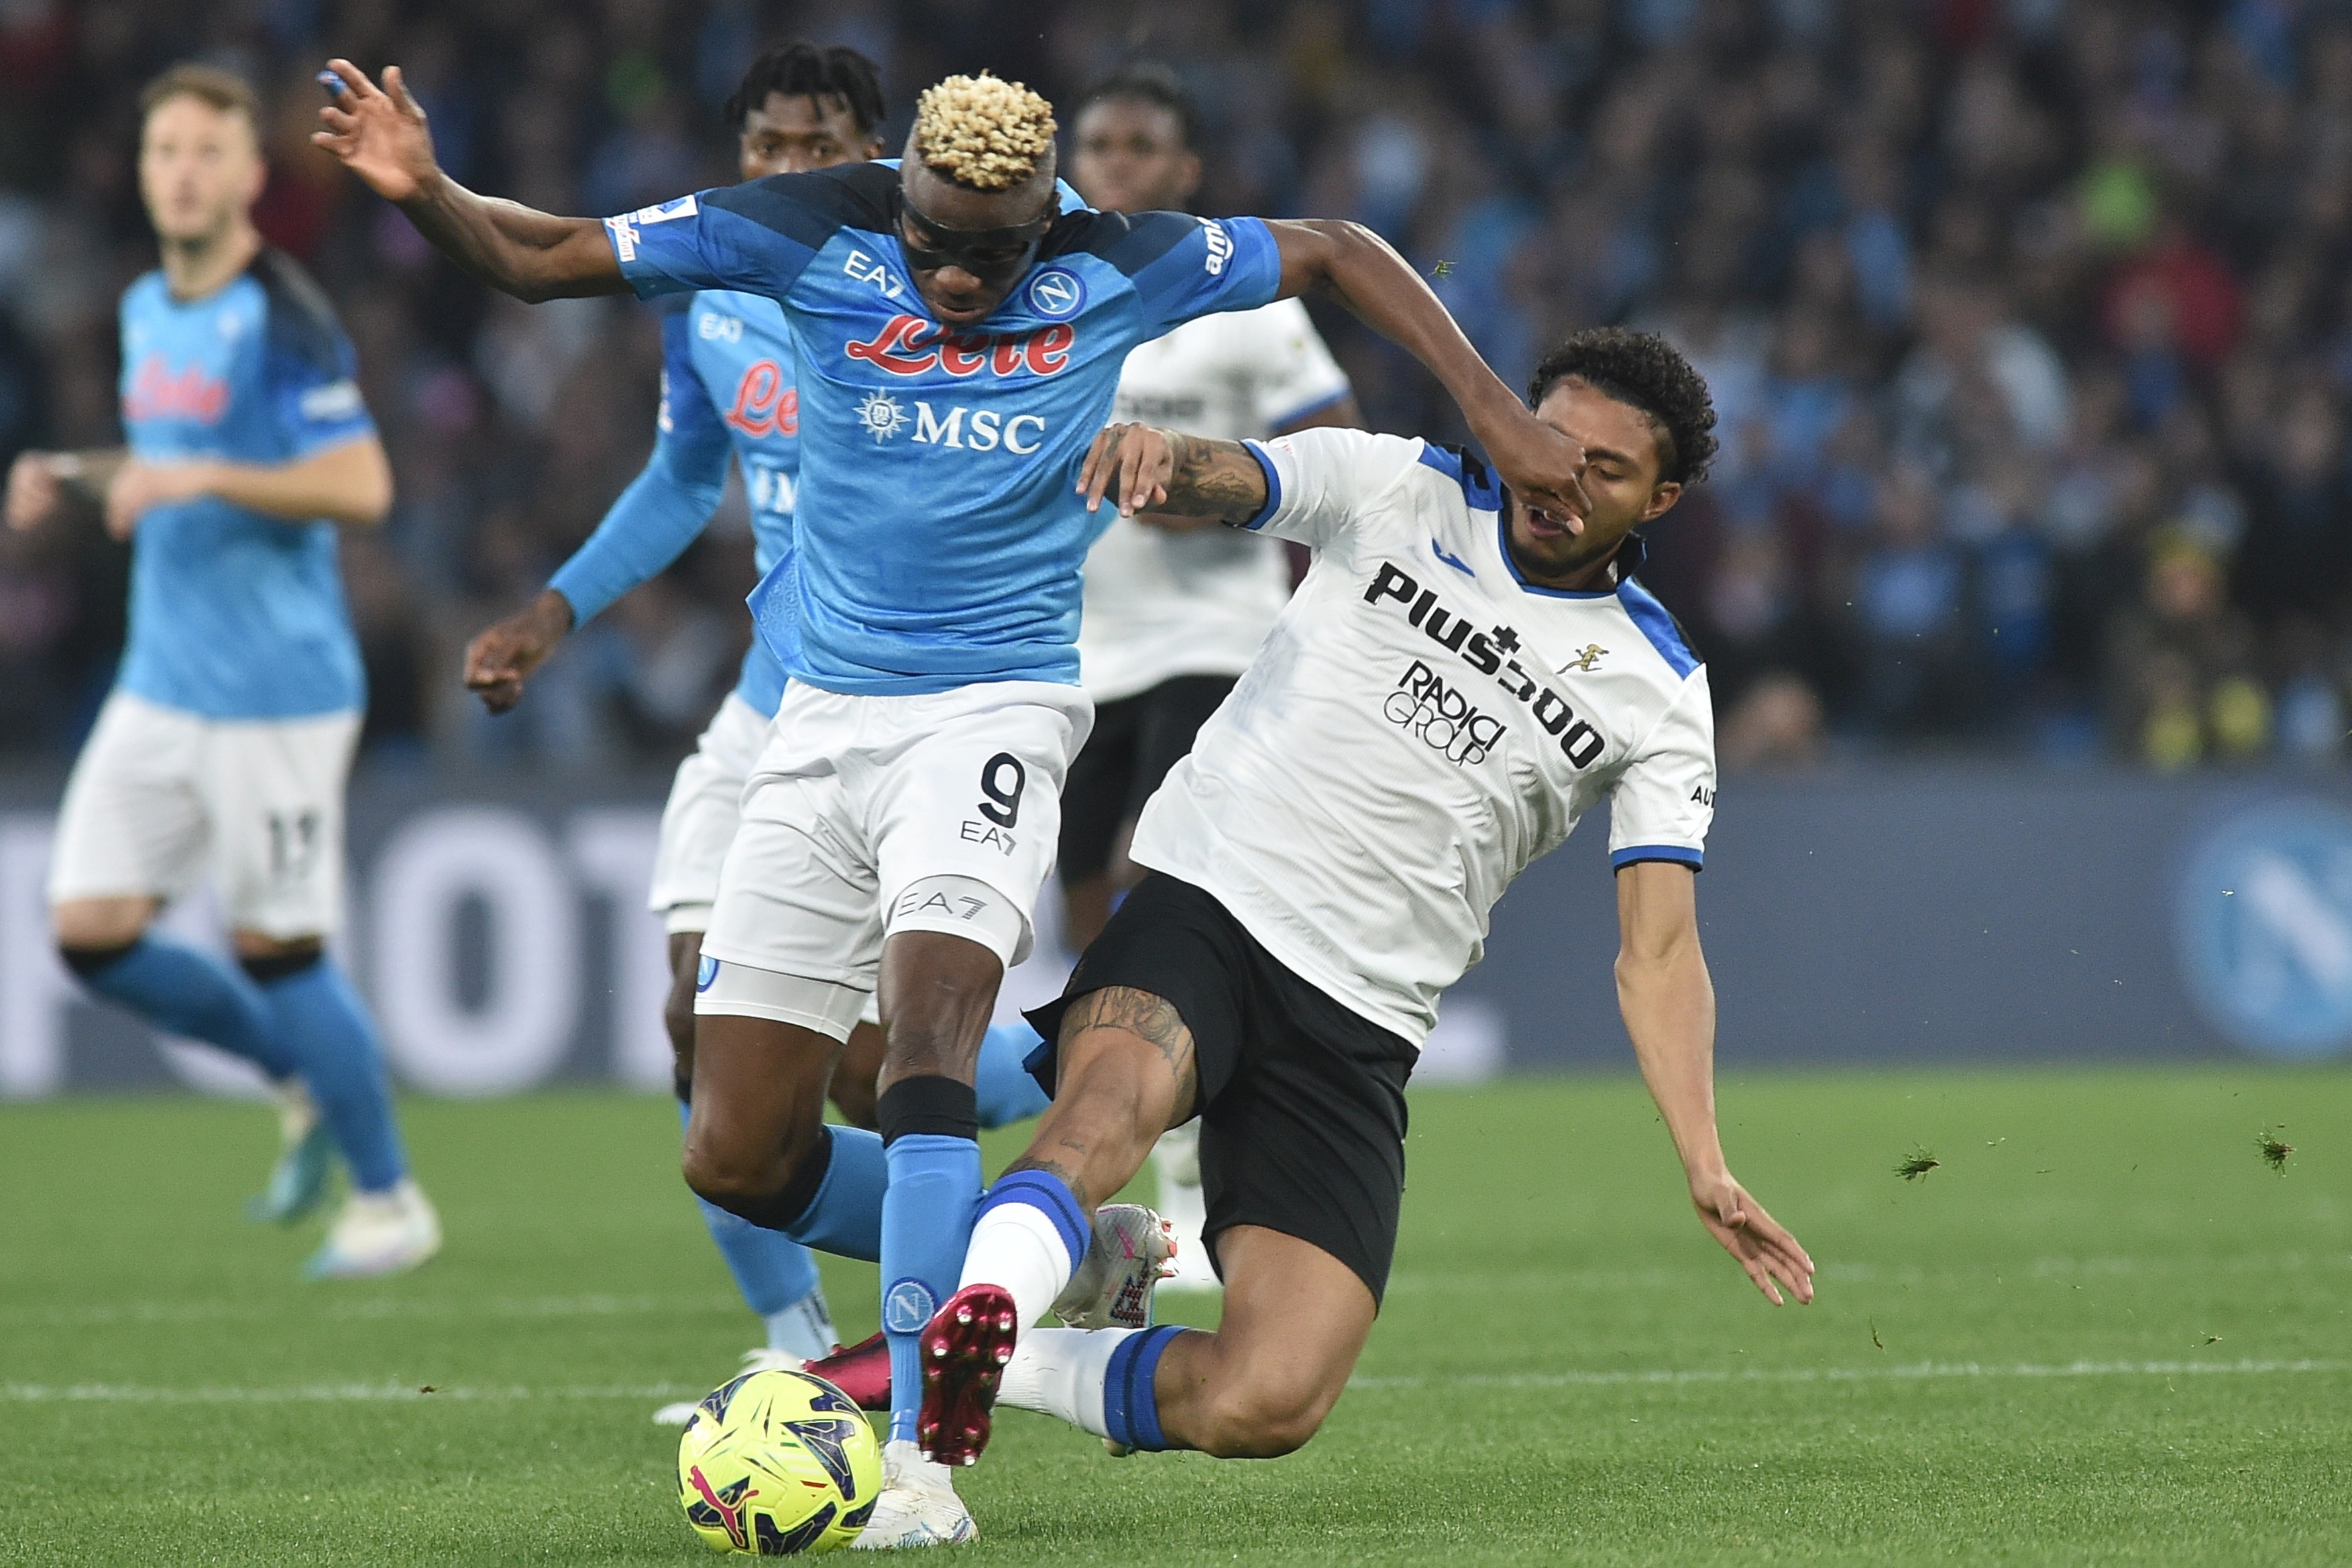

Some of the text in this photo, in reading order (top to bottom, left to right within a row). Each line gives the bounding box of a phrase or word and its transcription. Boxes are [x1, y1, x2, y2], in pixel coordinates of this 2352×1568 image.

[843, 249, 907, 298] EA7
[1036, 276, 1073, 310] N
[844, 314, 1075, 377] Lete
[723, 357, 799, 437] Le
[911, 401, 1046, 455] MSC
[1384, 691, 1485, 767] GROUP
[1398, 660, 1506, 752] RADICI
[977, 752, 1025, 829] 9
[960, 820, 1017, 856] EA7
[898, 891, 988, 920] EA7
[893, 1292, 919, 1323] N
